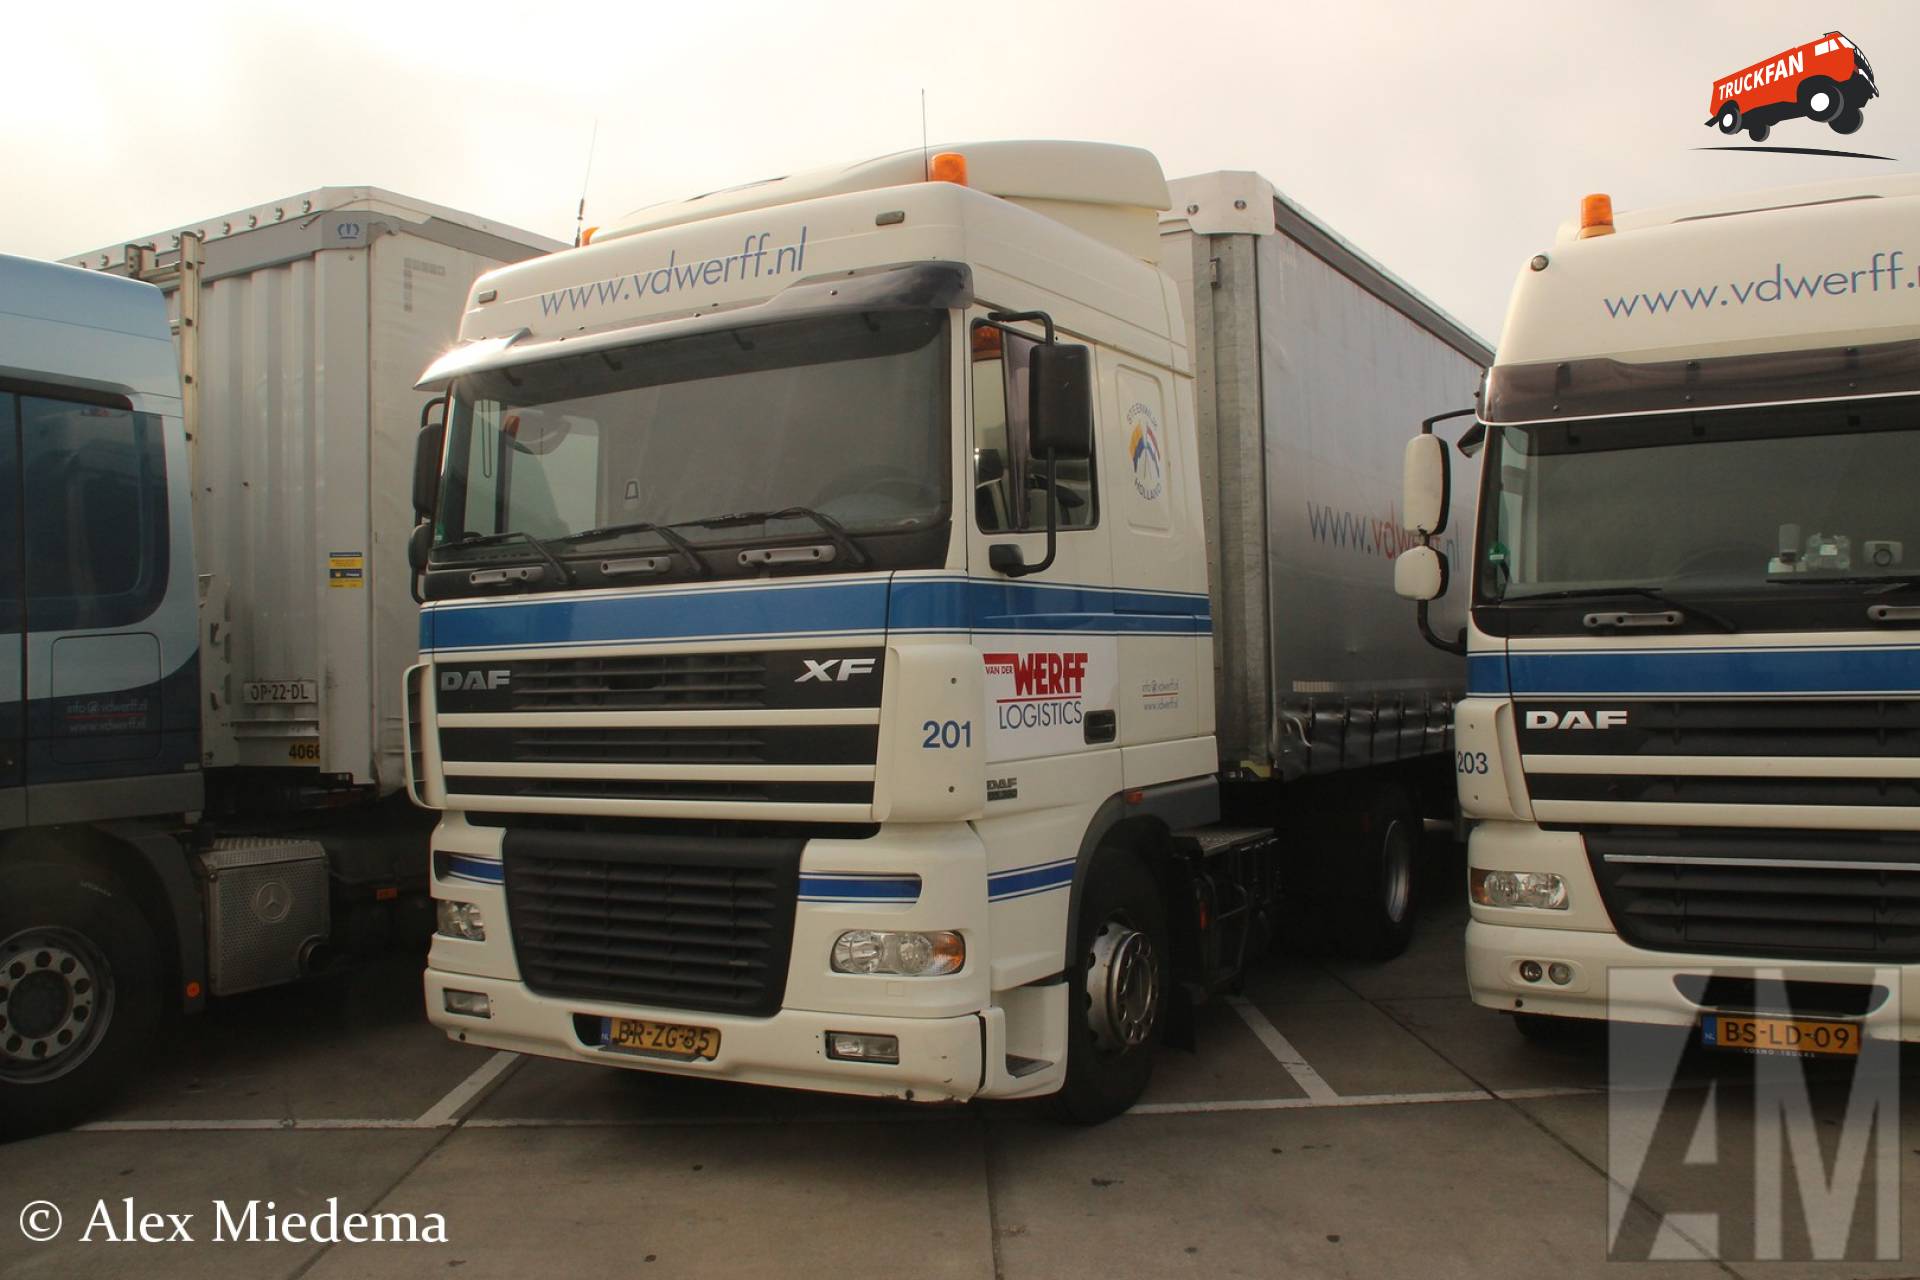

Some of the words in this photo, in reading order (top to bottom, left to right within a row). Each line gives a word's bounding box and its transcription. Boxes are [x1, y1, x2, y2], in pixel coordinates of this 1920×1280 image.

[541, 226, 807, 317] www.vdwerff.nl
[1603, 251, 1920, 319] www.vdwerff.
[441, 670, 510, 690] DAF
[795, 658, 876, 682] XF
[985, 666, 1000, 674] VAN
[1001, 665, 1013, 674] DER
[1012, 653, 1088, 696] WERFF
[999, 701, 1082, 730] LOGISTICS
[1526, 711, 1627, 729] DAF
[923, 720, 971, 749] 201
[1458, 752, 1488, 774] 203
[1725, 1022, 1849, 1048] BS-LD-09
